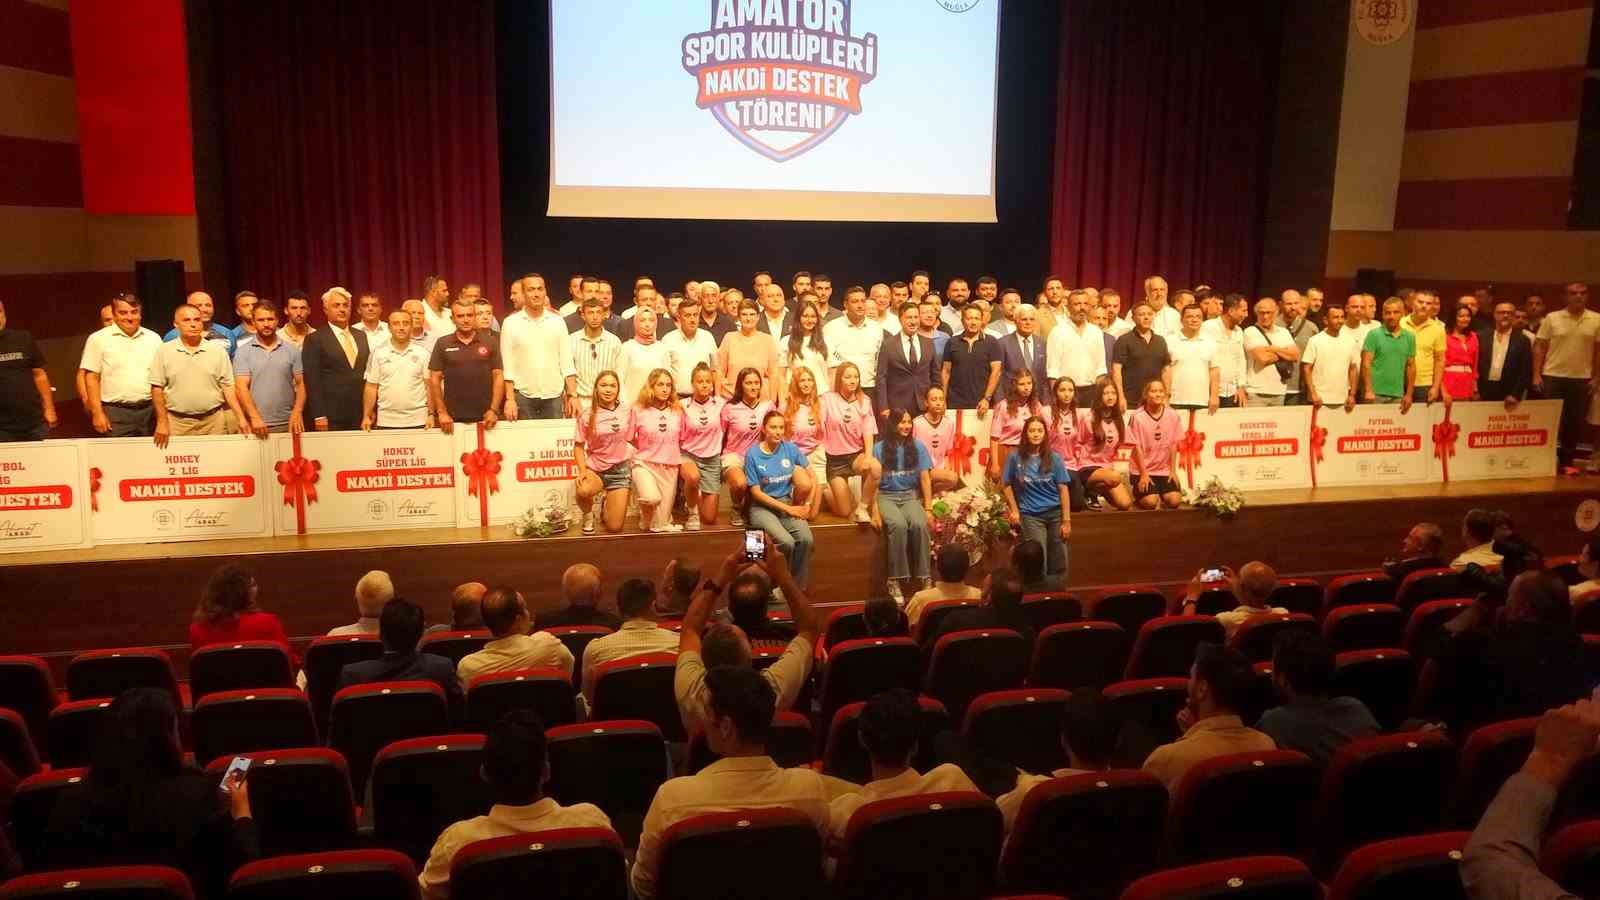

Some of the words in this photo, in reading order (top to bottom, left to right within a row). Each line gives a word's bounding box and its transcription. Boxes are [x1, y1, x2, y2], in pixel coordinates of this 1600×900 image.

[685, 33, 745, 67] SPOR
[751, 29, 874, 75] KULÜPLERİ
[772, 68, 849, 100] DESTEK
[165, 455, 200, 464] HOKEY
[383, 447, 416, 457] HOKEY
[0, 462, 26, 472] BOL
[525, 463, 567, 479] NAKDİ
[346, 472, 393, 489] NAKDİ
[396, 473, 453, 488] DESTEK
[130, 482, 180, 498] NAKDİ
[184, 482, 246, 497] DESTEK
